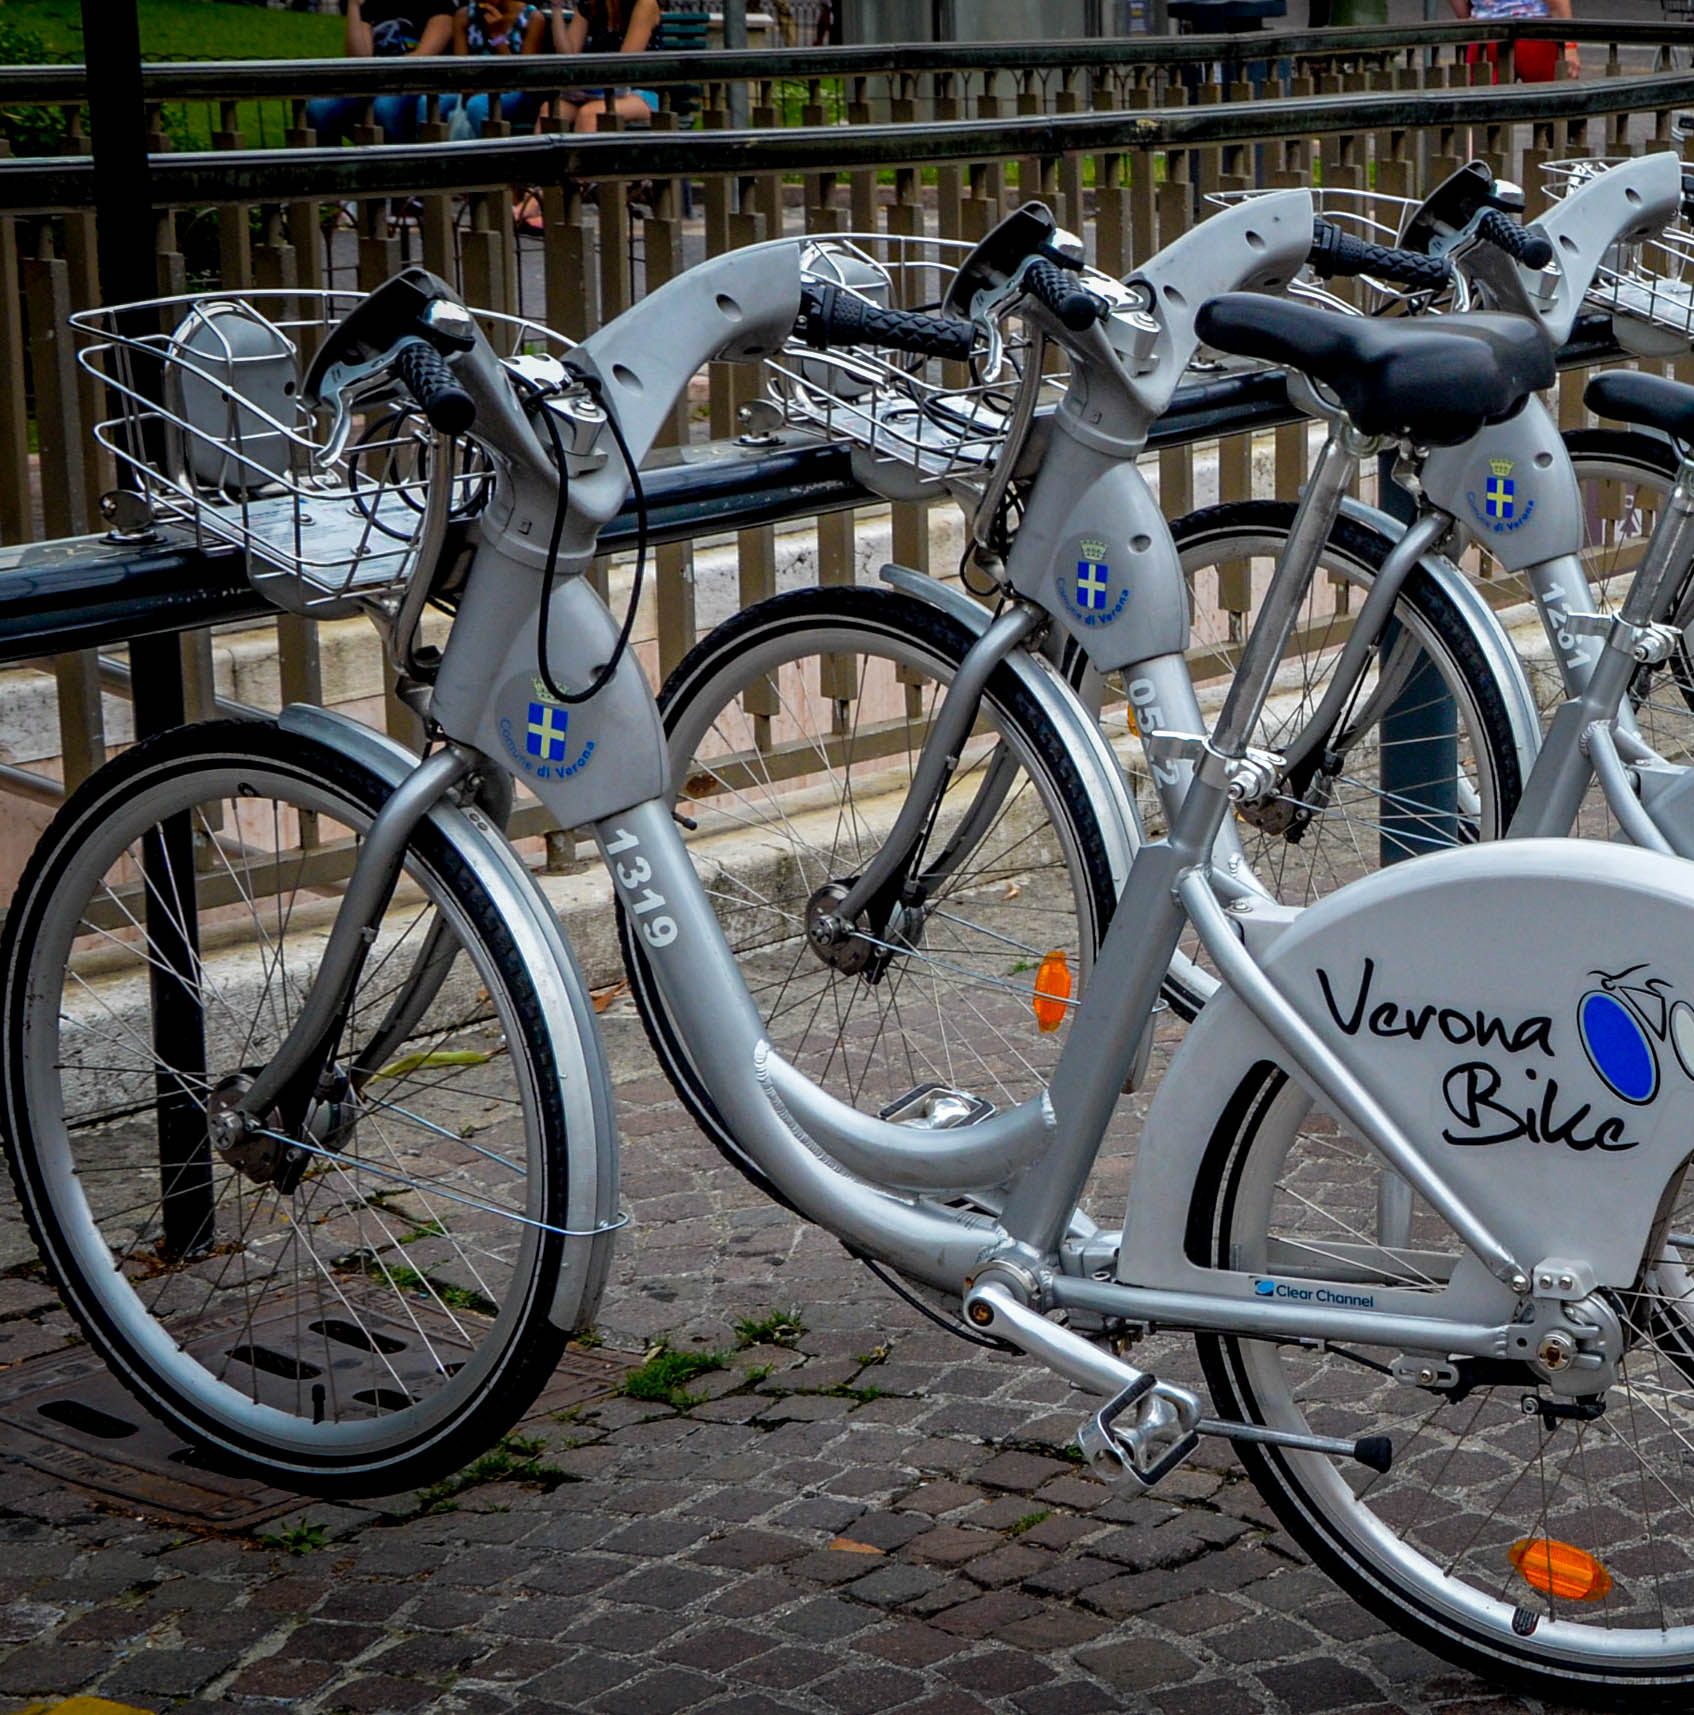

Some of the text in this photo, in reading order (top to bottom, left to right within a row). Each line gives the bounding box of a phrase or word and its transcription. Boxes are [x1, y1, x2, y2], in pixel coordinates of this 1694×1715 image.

[536, 764, 551, 779] di
[555, 740, 596, 779] Verona
[605, 827, 679, 948] 1319
[1315, 957, 1556, 1058] Verona
[1441, 1060, 1641, 1152] Bike
[1275, 1283, 1374, 1308] Clear Channel
